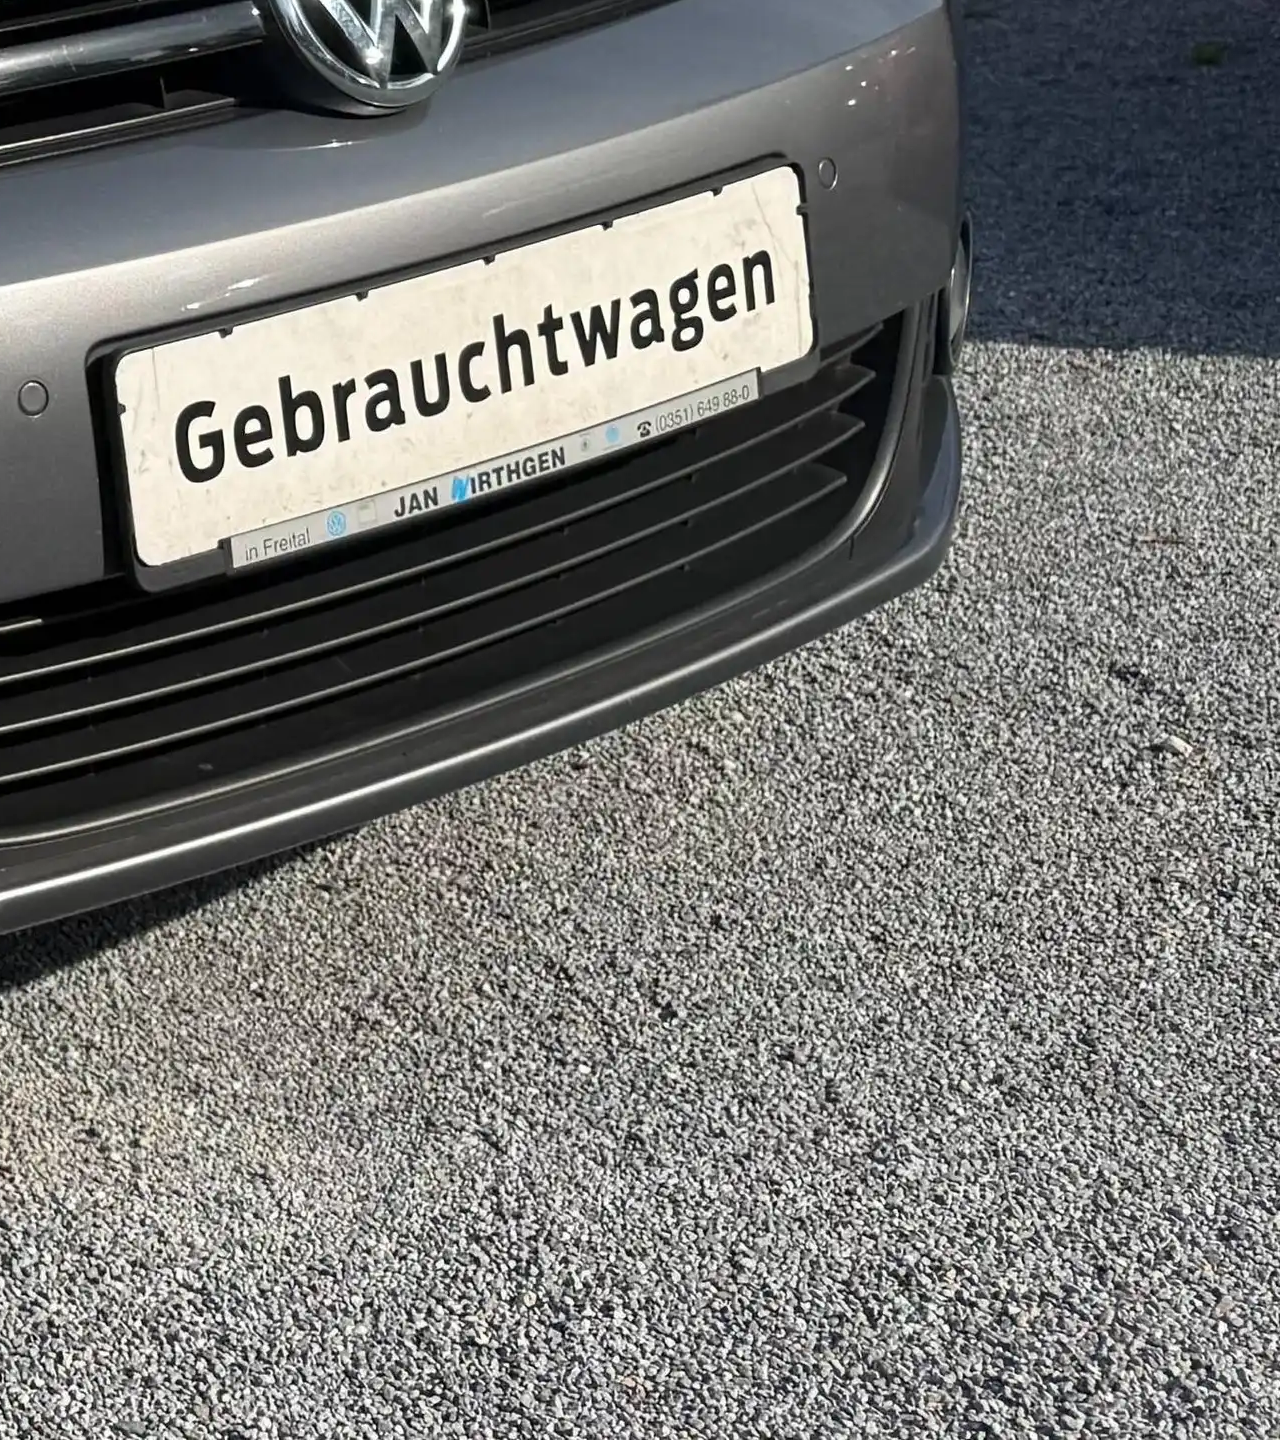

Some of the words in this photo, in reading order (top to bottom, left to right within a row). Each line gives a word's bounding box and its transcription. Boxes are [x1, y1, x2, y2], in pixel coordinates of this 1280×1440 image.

[174, 249, 776, 484] Gebrauchtwagen
[654, 403, 695, 434] (0351)
[697, 395, 720, 418] 649
[723, 384, 750, 408] 88-0
[394, 486, 439, 518] JAN
[244, 544, 259, 561] in
[262, 528, 311, 558] Freital
